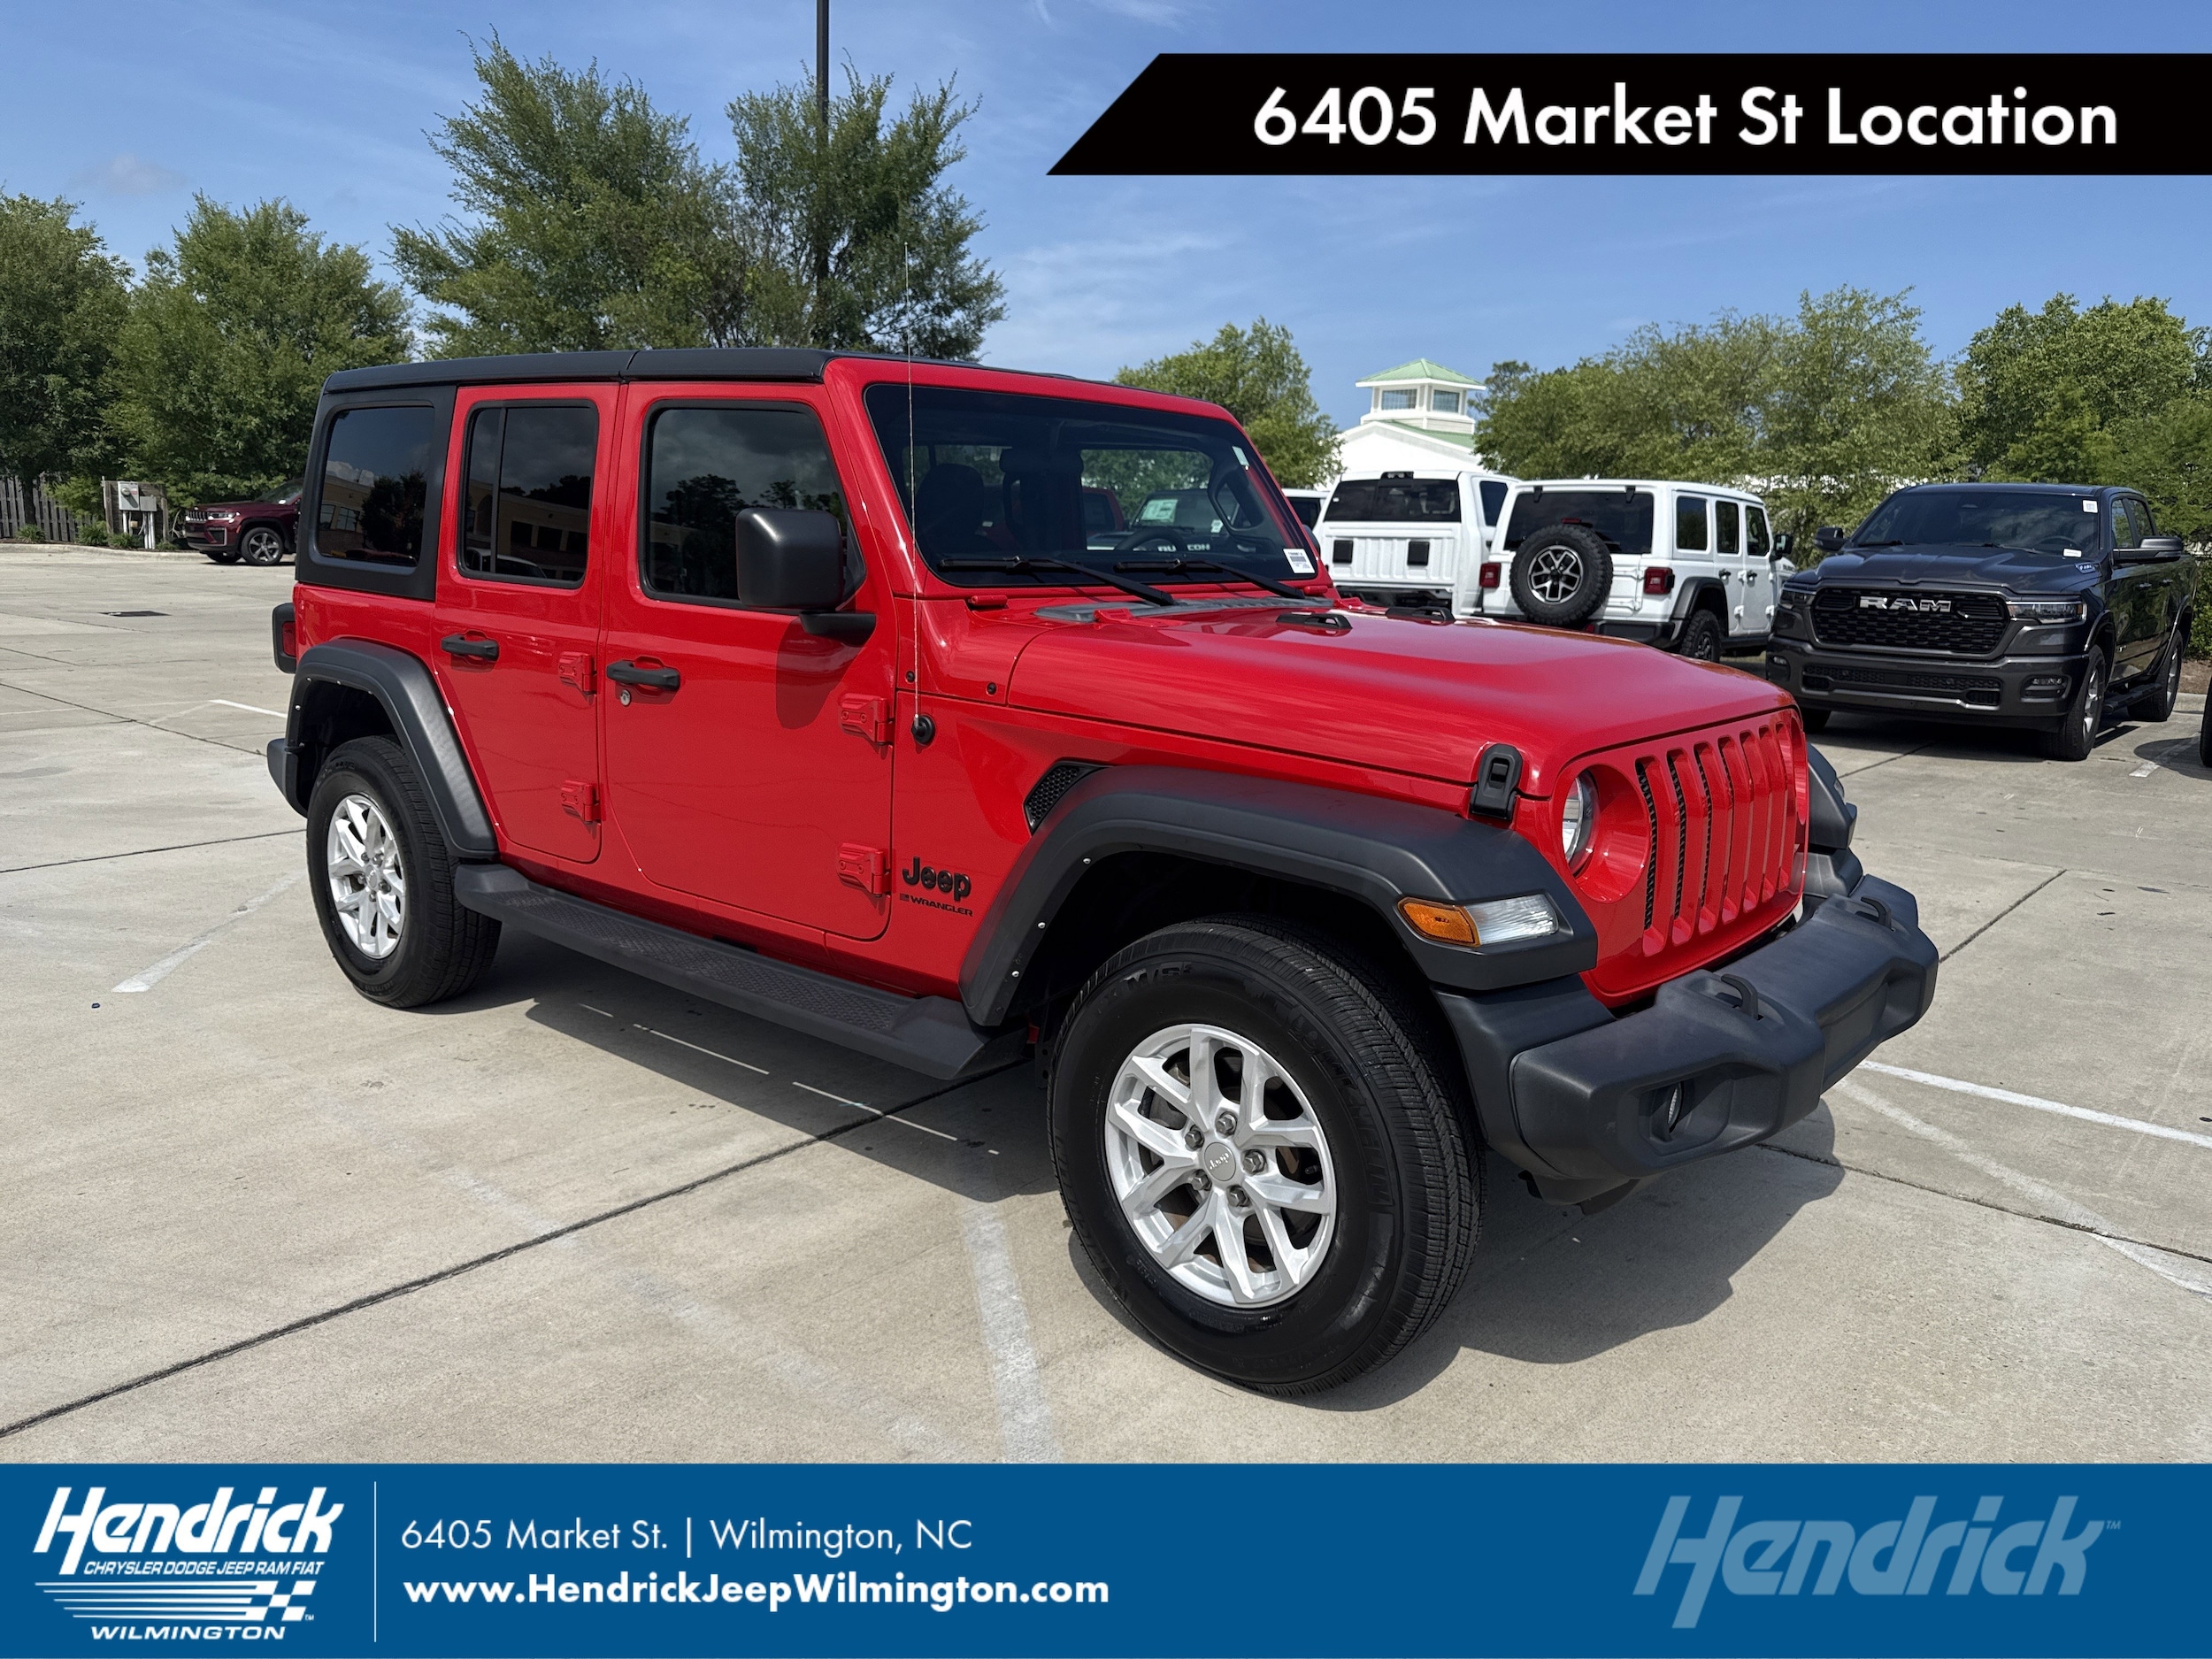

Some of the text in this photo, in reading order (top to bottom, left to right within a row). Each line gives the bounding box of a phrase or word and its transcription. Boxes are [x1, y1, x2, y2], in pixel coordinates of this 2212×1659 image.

[1859, 595, 1952, 613] RAM
[902, 856, 972, 902] Jeep
[910, 895, 973, 918] WRANGLER
